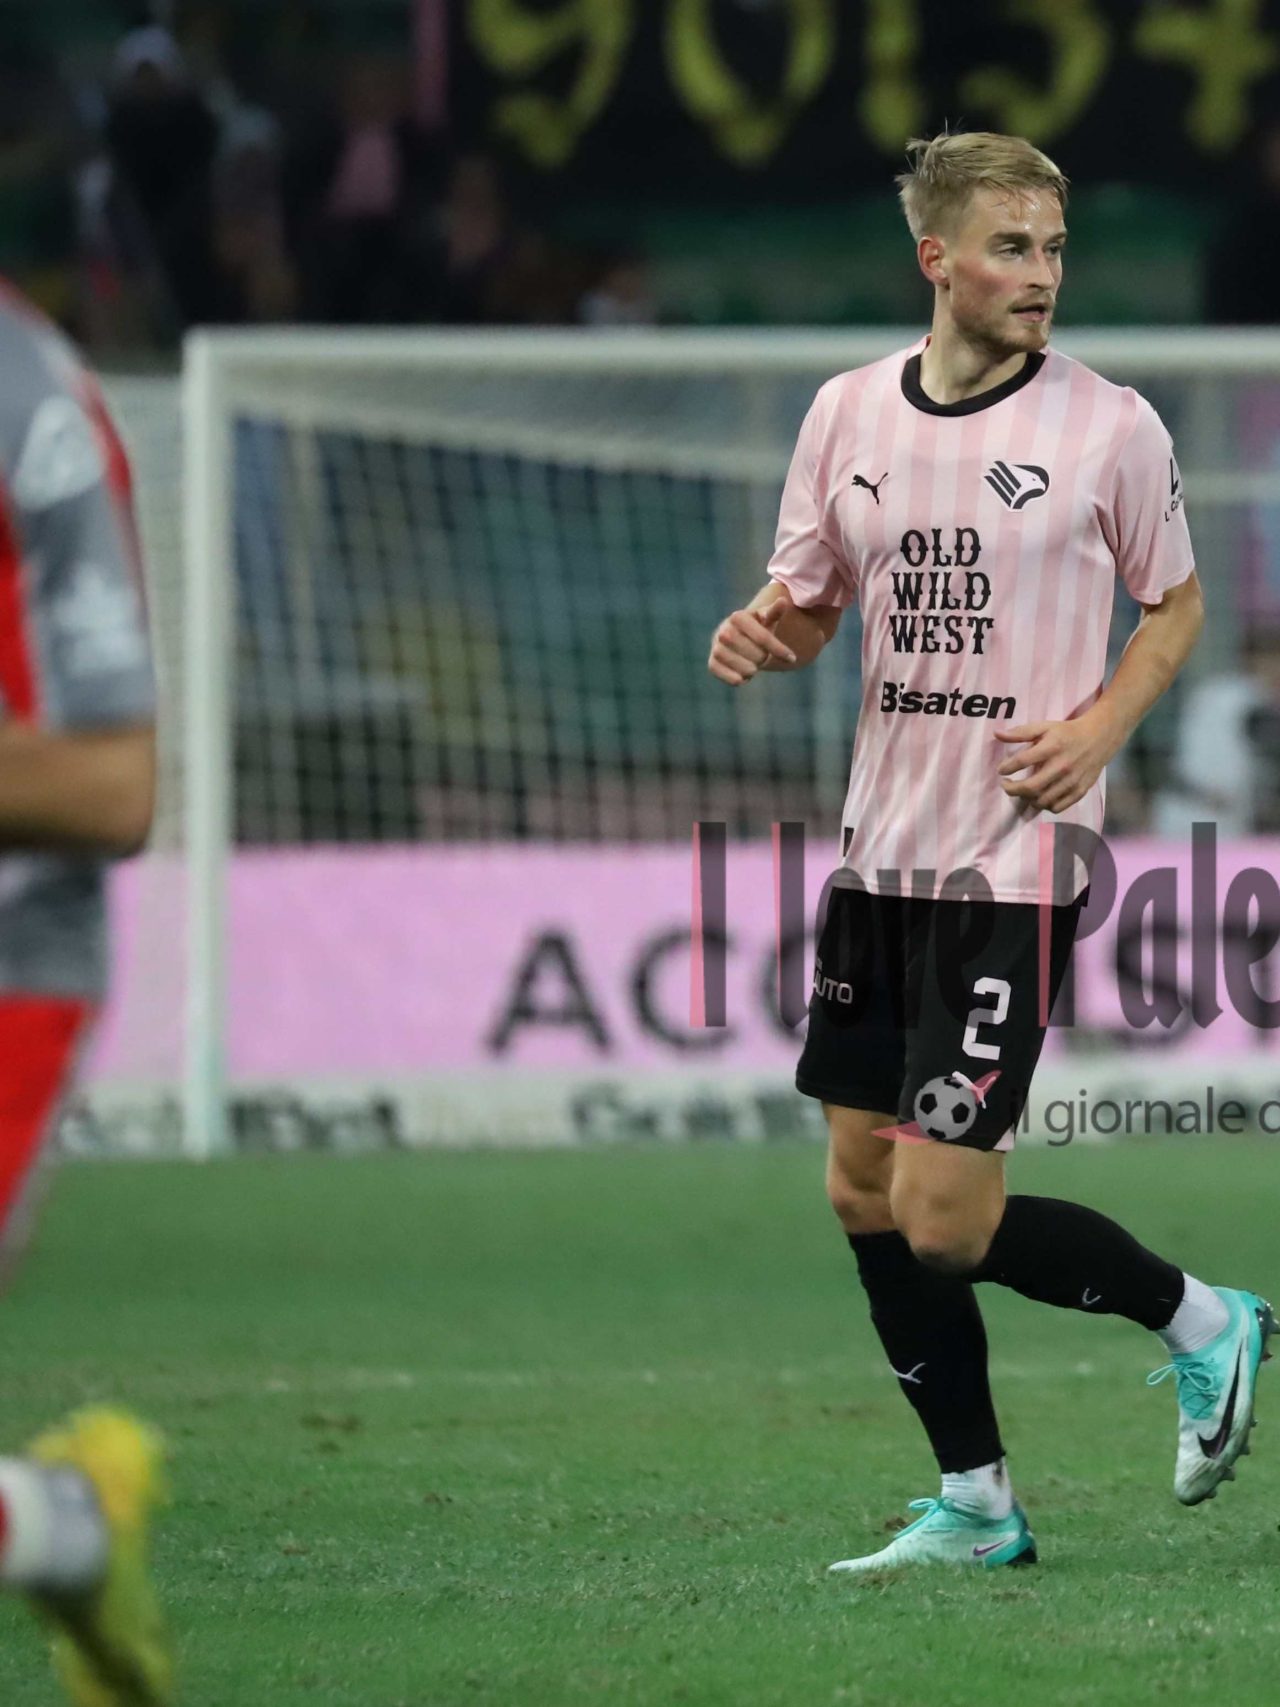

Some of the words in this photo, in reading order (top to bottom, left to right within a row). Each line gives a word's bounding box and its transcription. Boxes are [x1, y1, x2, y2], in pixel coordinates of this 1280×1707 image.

[900, 527, 983, 568] OLD
[892, 571, 992, 612] WILD
[888, 615, 995, 655] WEST
[880, 681, 1017, 720] Bisaten
[961, 976, 1012, 1061] 2
